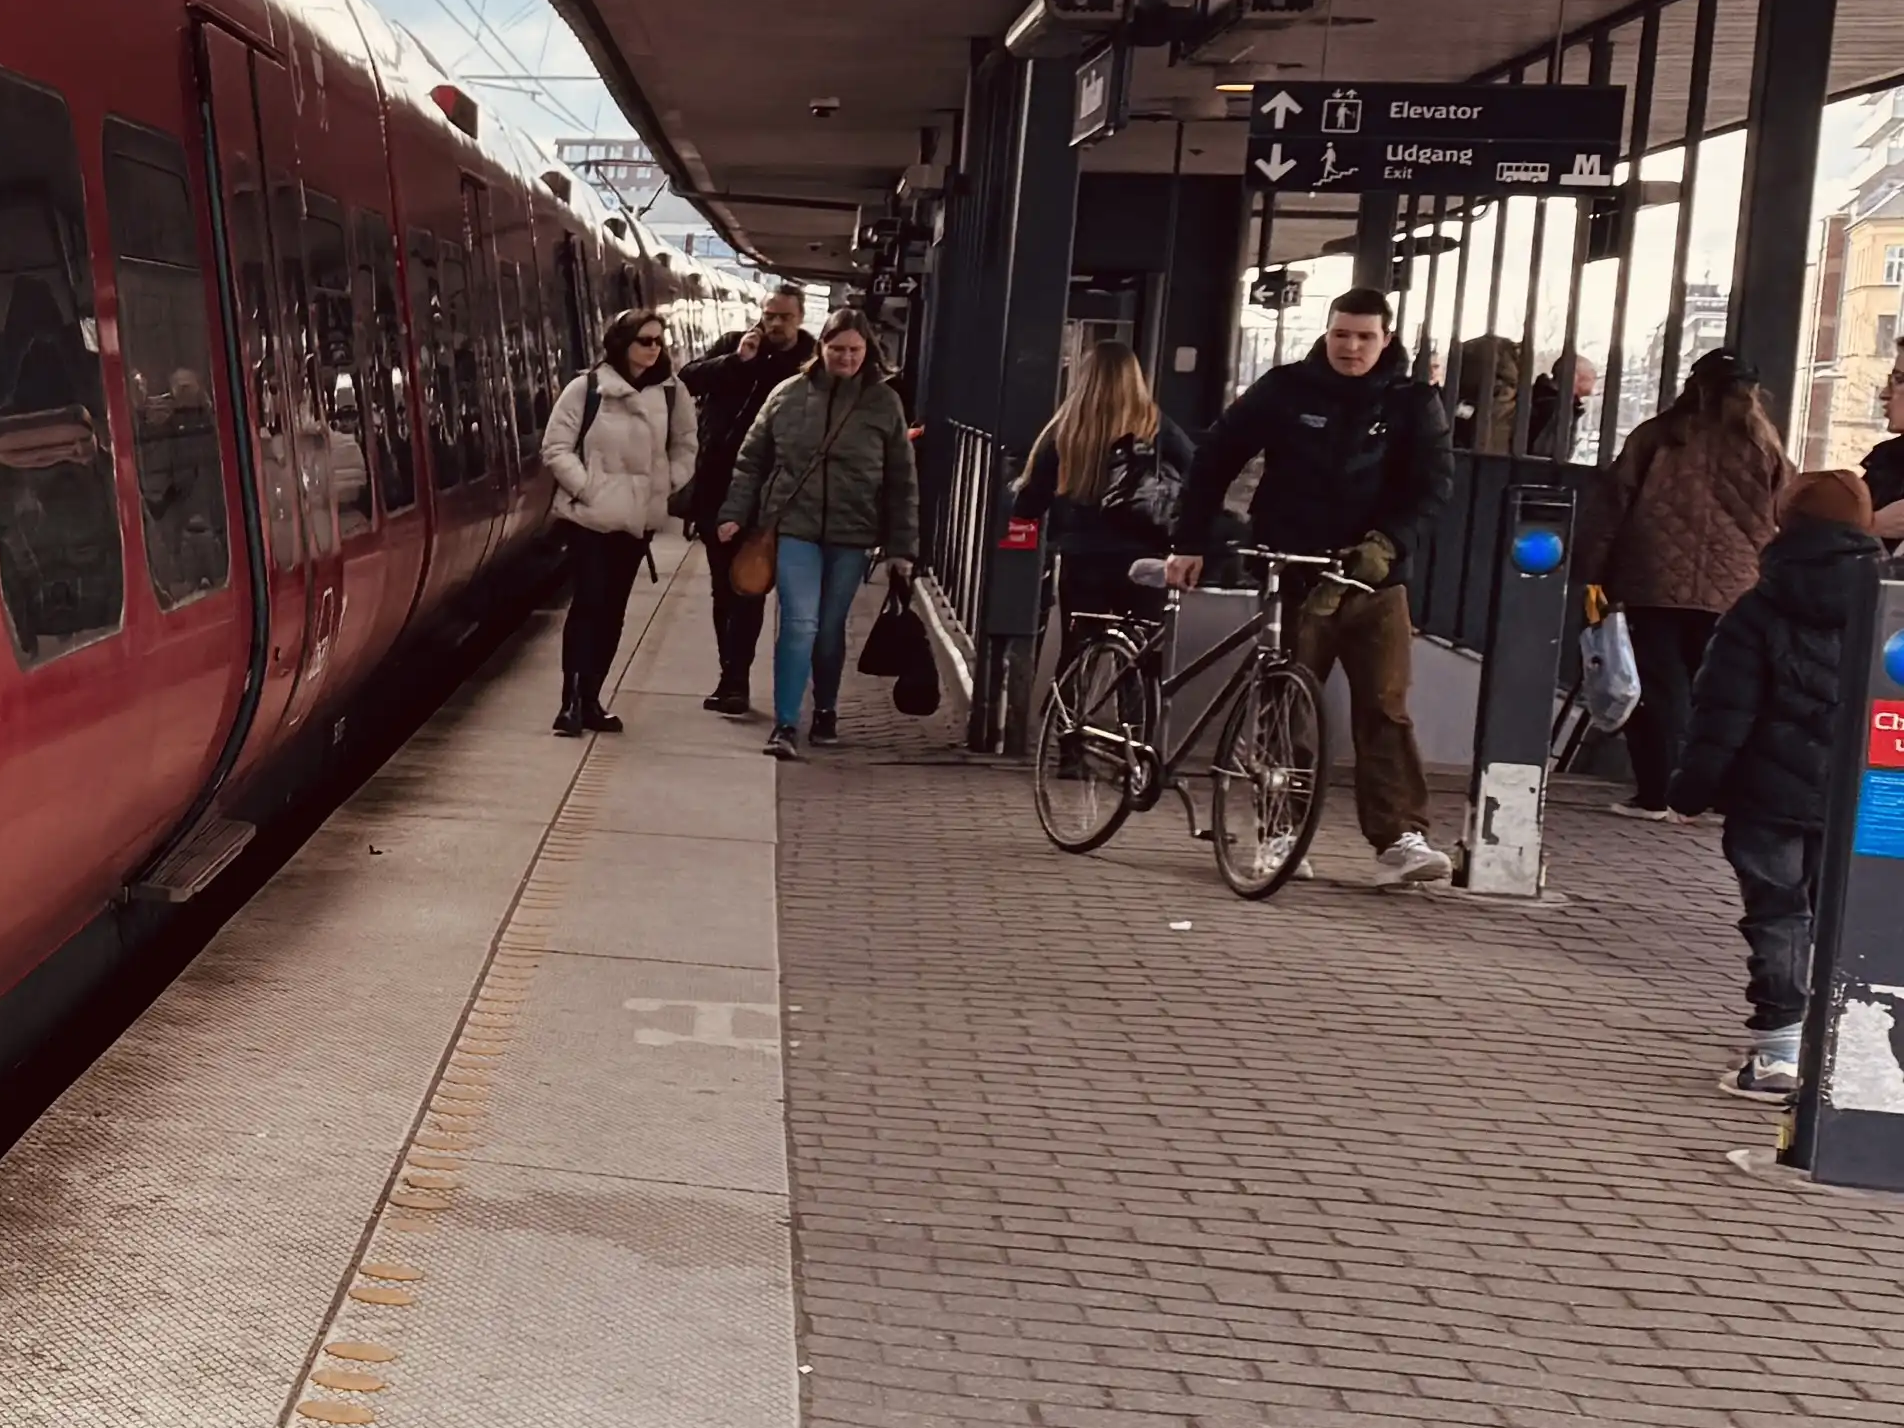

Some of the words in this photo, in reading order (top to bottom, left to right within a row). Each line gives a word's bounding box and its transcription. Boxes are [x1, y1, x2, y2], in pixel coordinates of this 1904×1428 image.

[1389, 101, 1483, 120] Elevator
[1386, 144, 1473, 166] Udgang
[1383, 166, 1413, 180] Exit
